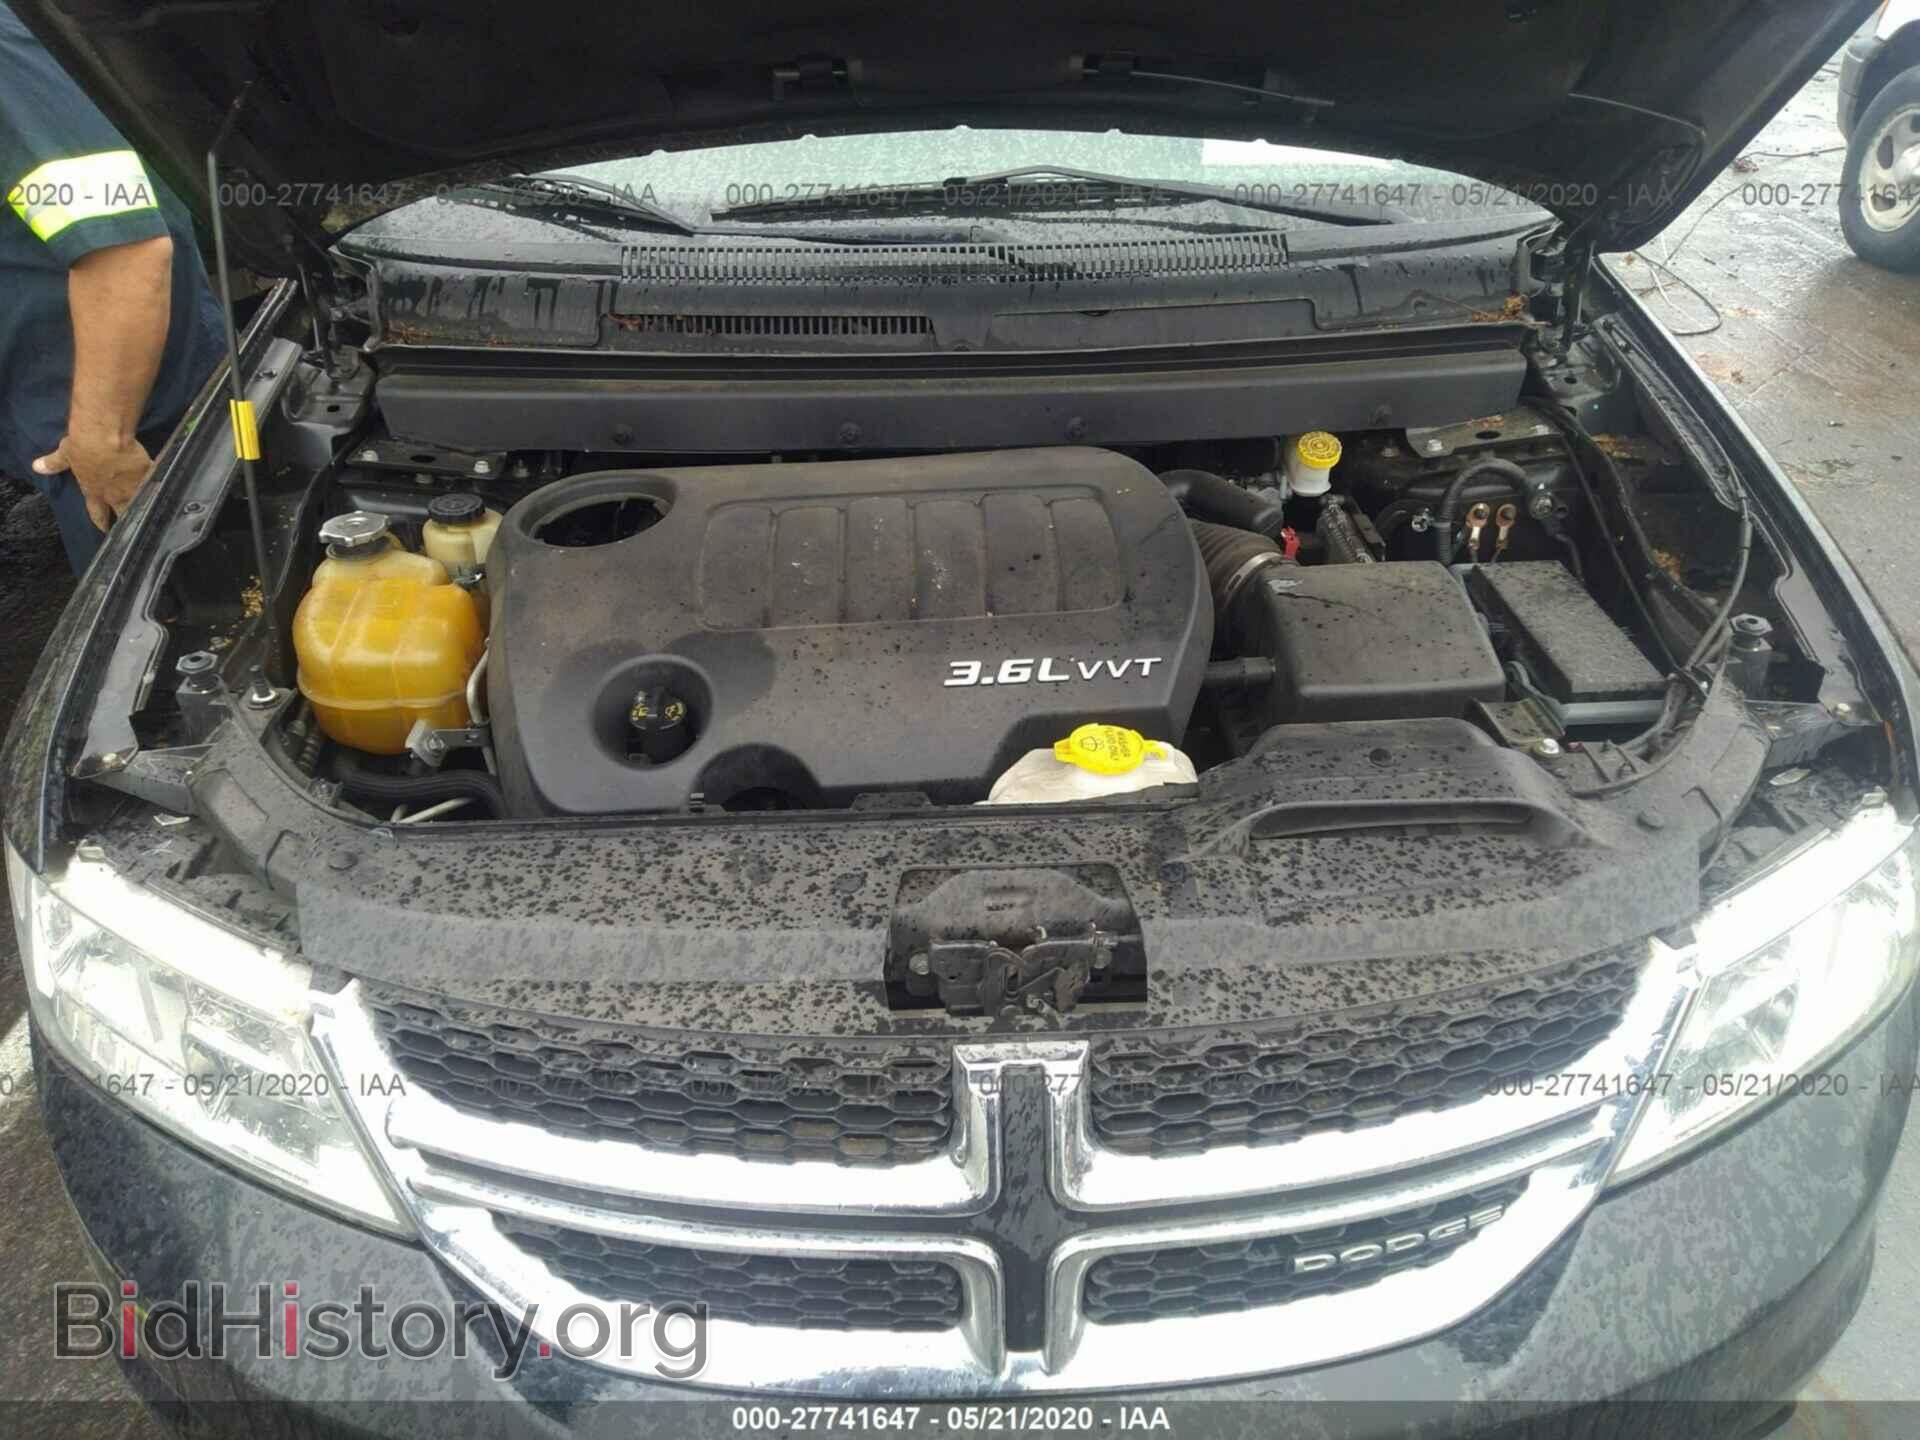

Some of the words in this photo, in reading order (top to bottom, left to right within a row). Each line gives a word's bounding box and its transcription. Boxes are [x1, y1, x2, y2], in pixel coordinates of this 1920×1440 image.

[944, 657, 1069, 687] 3.6L
[1077, 656, 1162, 680] VVT
[1294, 1204, 1504, 1273] DODGE
